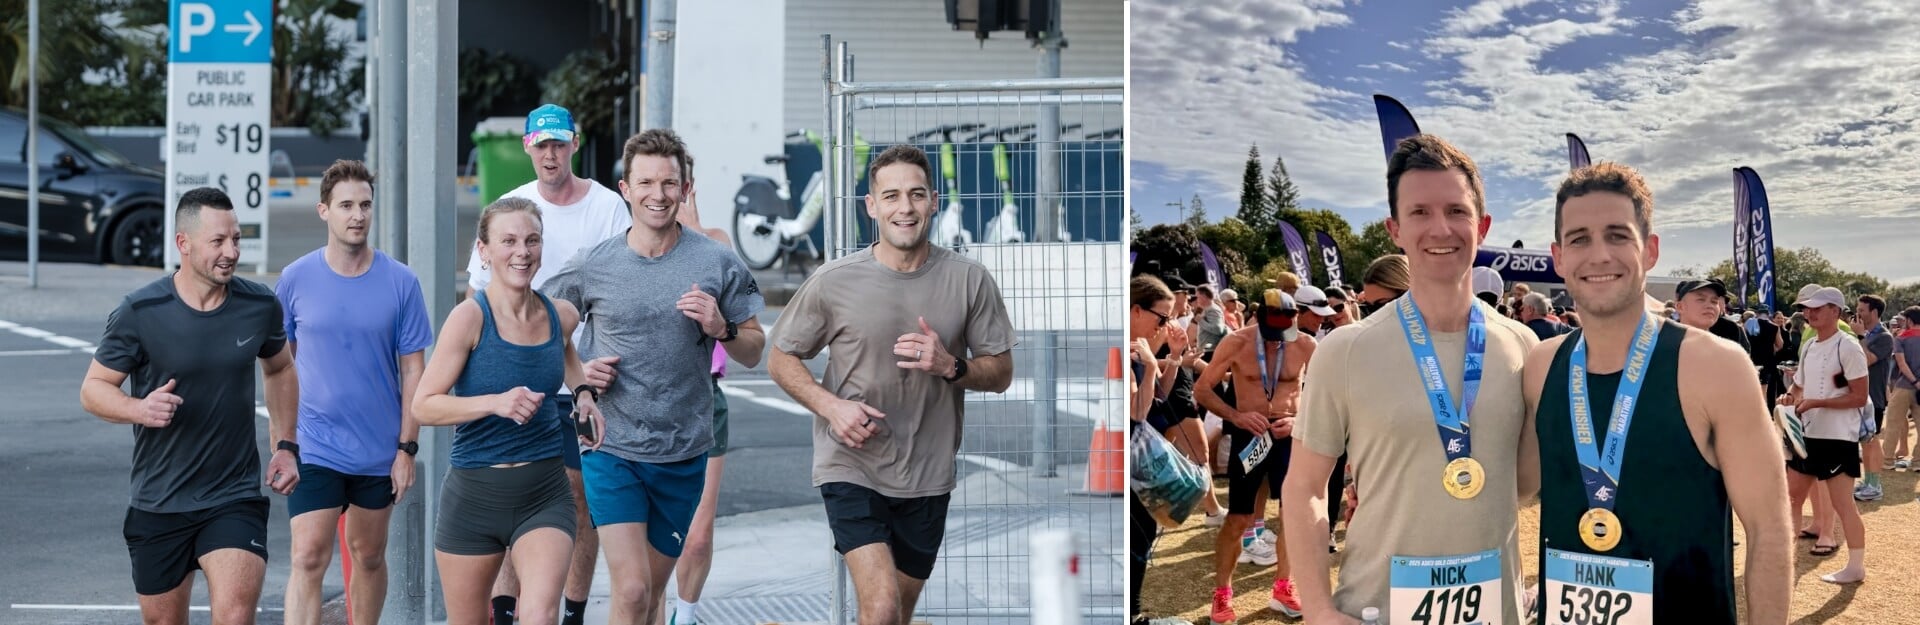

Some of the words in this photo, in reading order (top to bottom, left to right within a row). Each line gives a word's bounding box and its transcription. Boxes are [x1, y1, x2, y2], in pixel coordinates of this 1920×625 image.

[179, 2, 216, 53] P
[197, 70, 246, 86] PUBLIC
[187, 92, 215, 107] CAR
[219, 92, 254, 107] PARK
[176, 121, 200, 136] Early
[176, 142, 197, 153] Bird
[176, 172, 210, 185] Casual
[246, 173, 262, 208] 8
[1510, 255, 1548, 272] asics
[1426, 355, 1445, 390] MARATHON
[1572, 364, 1584, 394] 42KM
[1626, 351, 1647, 384] 42KM
[1574, 396, 1593, 445] FINISHER
[1616, 395, 1633, 433] MARATHON
[1431, 565, 1467, 586] NICK
[1575, 562, 1616, 587] HANK
[1411, 584, 1482, 625] 4119
[1560, 584, 1632, 625] 5392
